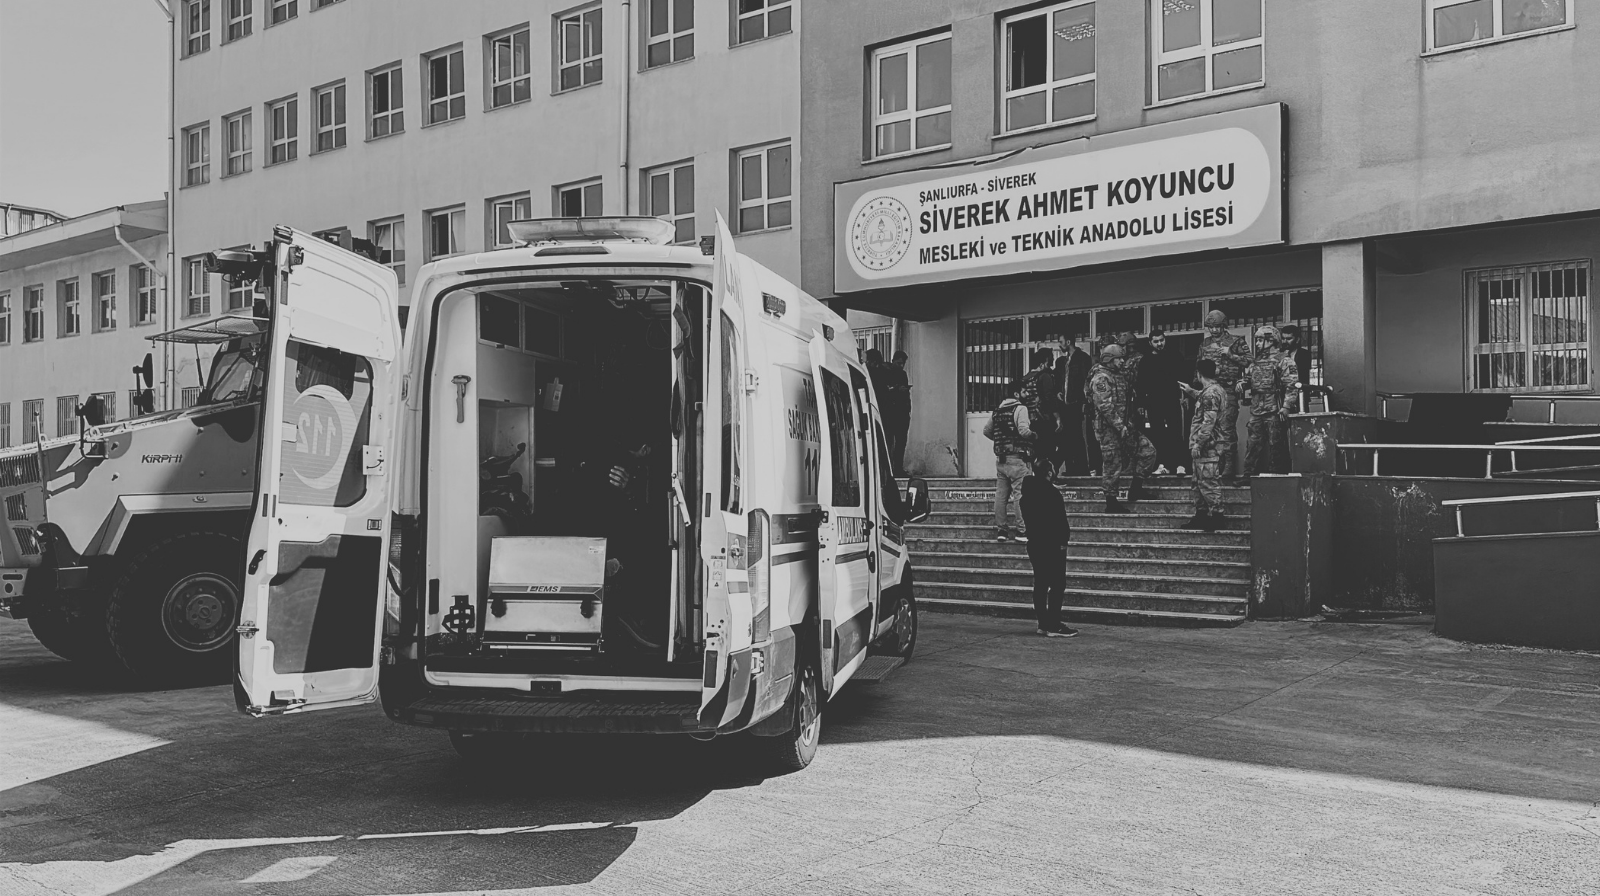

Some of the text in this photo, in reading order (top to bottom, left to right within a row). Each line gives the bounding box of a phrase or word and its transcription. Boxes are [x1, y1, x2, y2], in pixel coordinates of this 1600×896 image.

[920, 183, 978, 206] ŞANLIURFA
[988, 173, 1036, 192] SİVEREK
[920, 163, 1234, 234] SİVEREK AHMET KOYUNCU
[920, 201, 1232, 264] MESLEKİ ve TEKNİK ANADOLU LİSESİ
[805, 448, 819, 496] 11
